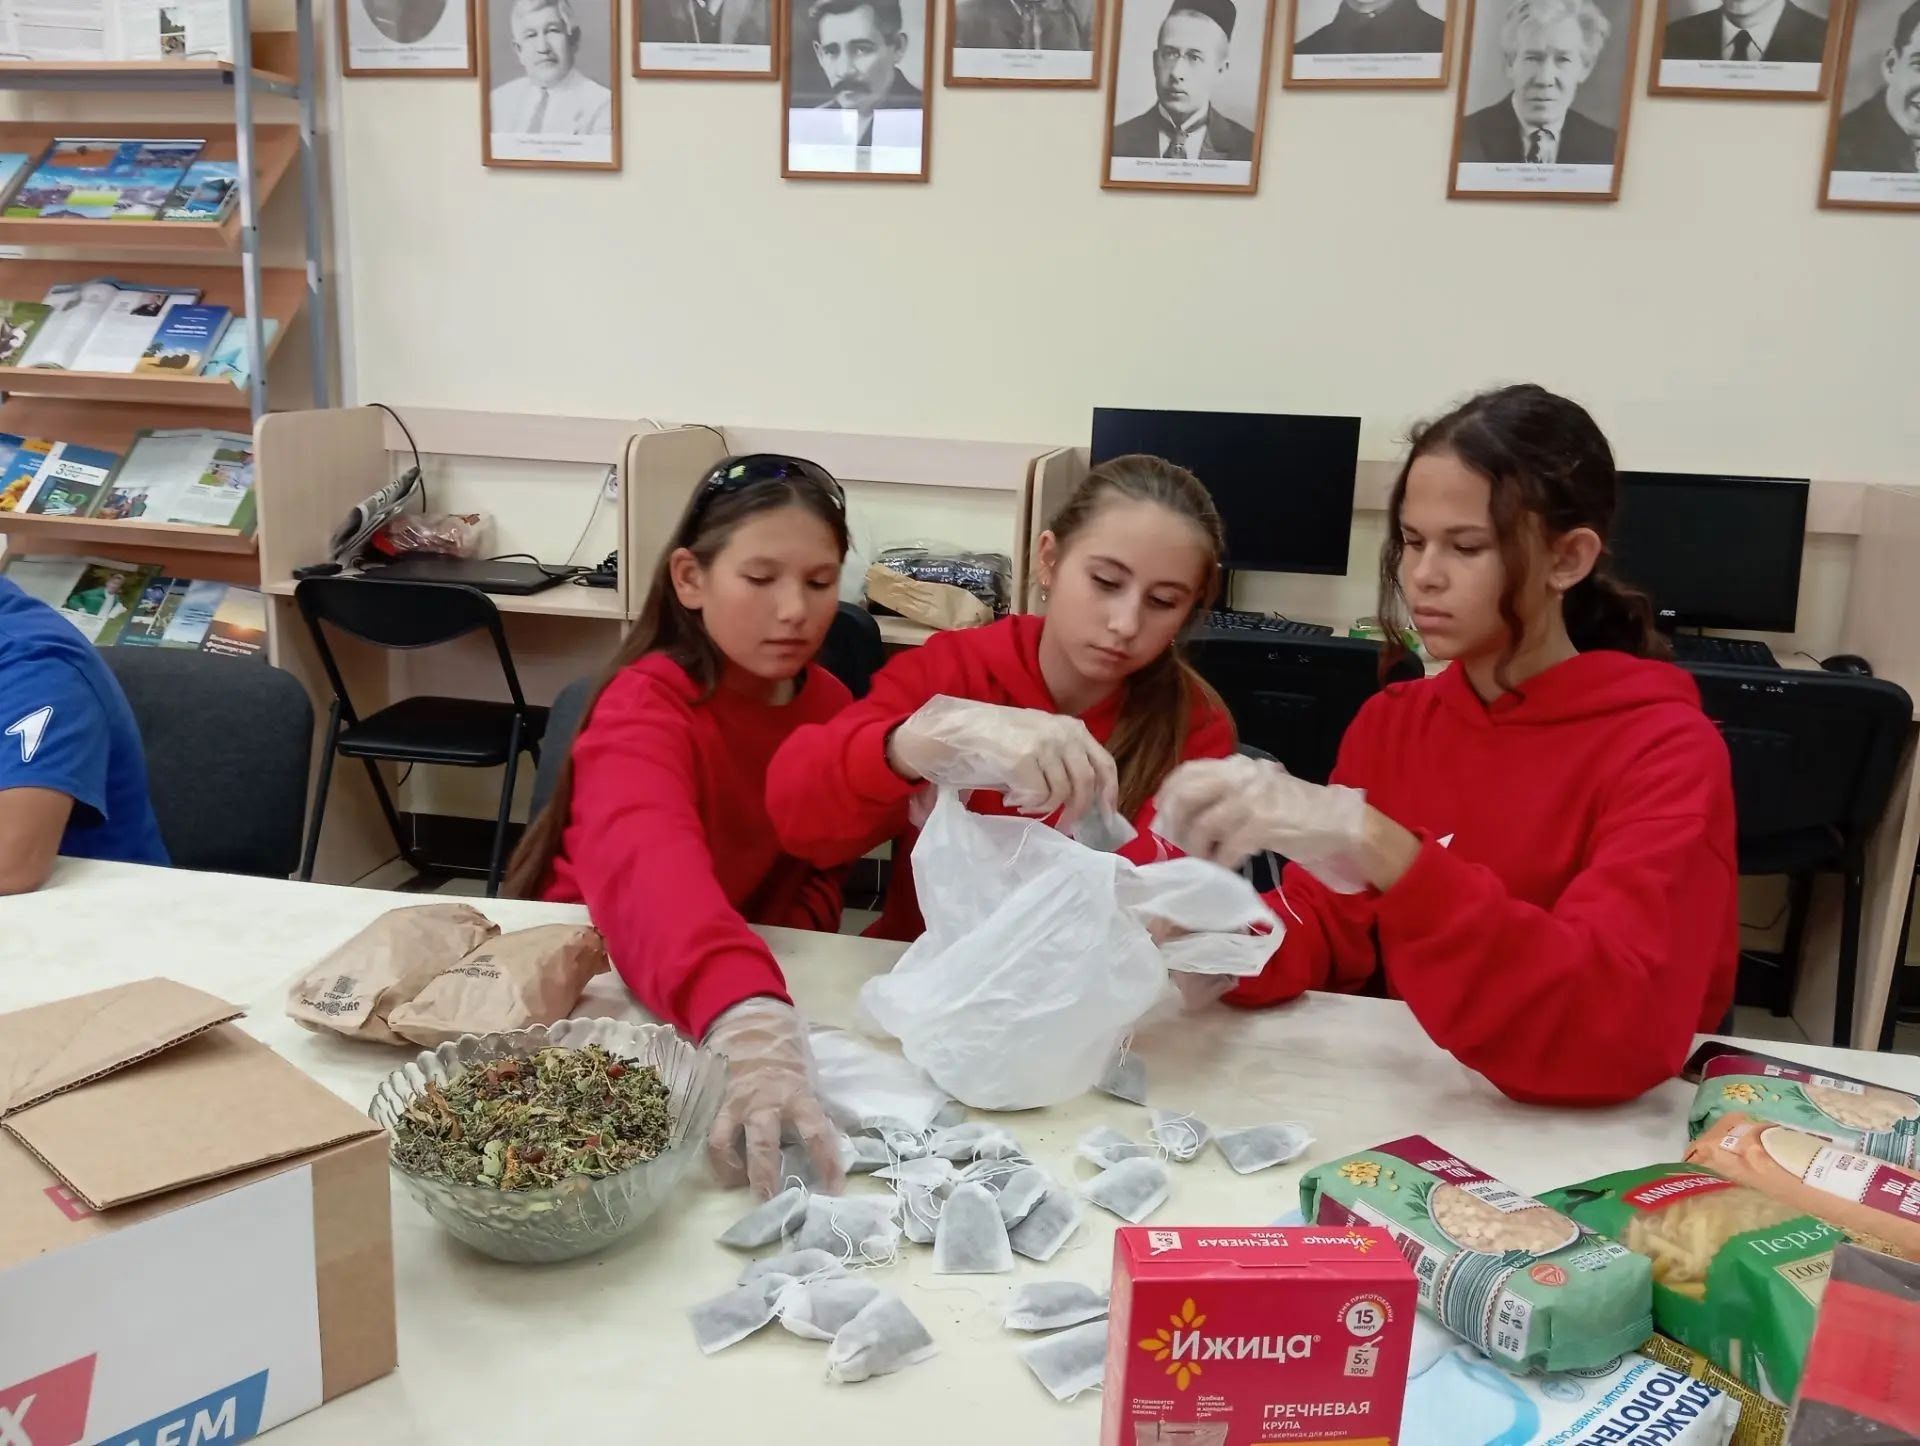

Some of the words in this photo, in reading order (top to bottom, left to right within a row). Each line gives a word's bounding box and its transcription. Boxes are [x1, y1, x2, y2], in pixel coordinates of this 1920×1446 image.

[1198, 1238, 1289, 1248] ГРЕЧНЕВАЯ
[1748, 1223, 1829, 1255] Перья
[1788, 1260, 1830, 1279] 100%
[1355, 1309, 1374, 1325] 15
[1263, 1401, 1370, 1418] ГРЕЧНЕВАЯ
[1575, 1367, 1690, 1446] ПОЛОТЕН
[1262, 1421, 1301, 1430] КРУПА
[1268, 1431, 1307, 1439] пакетиках
